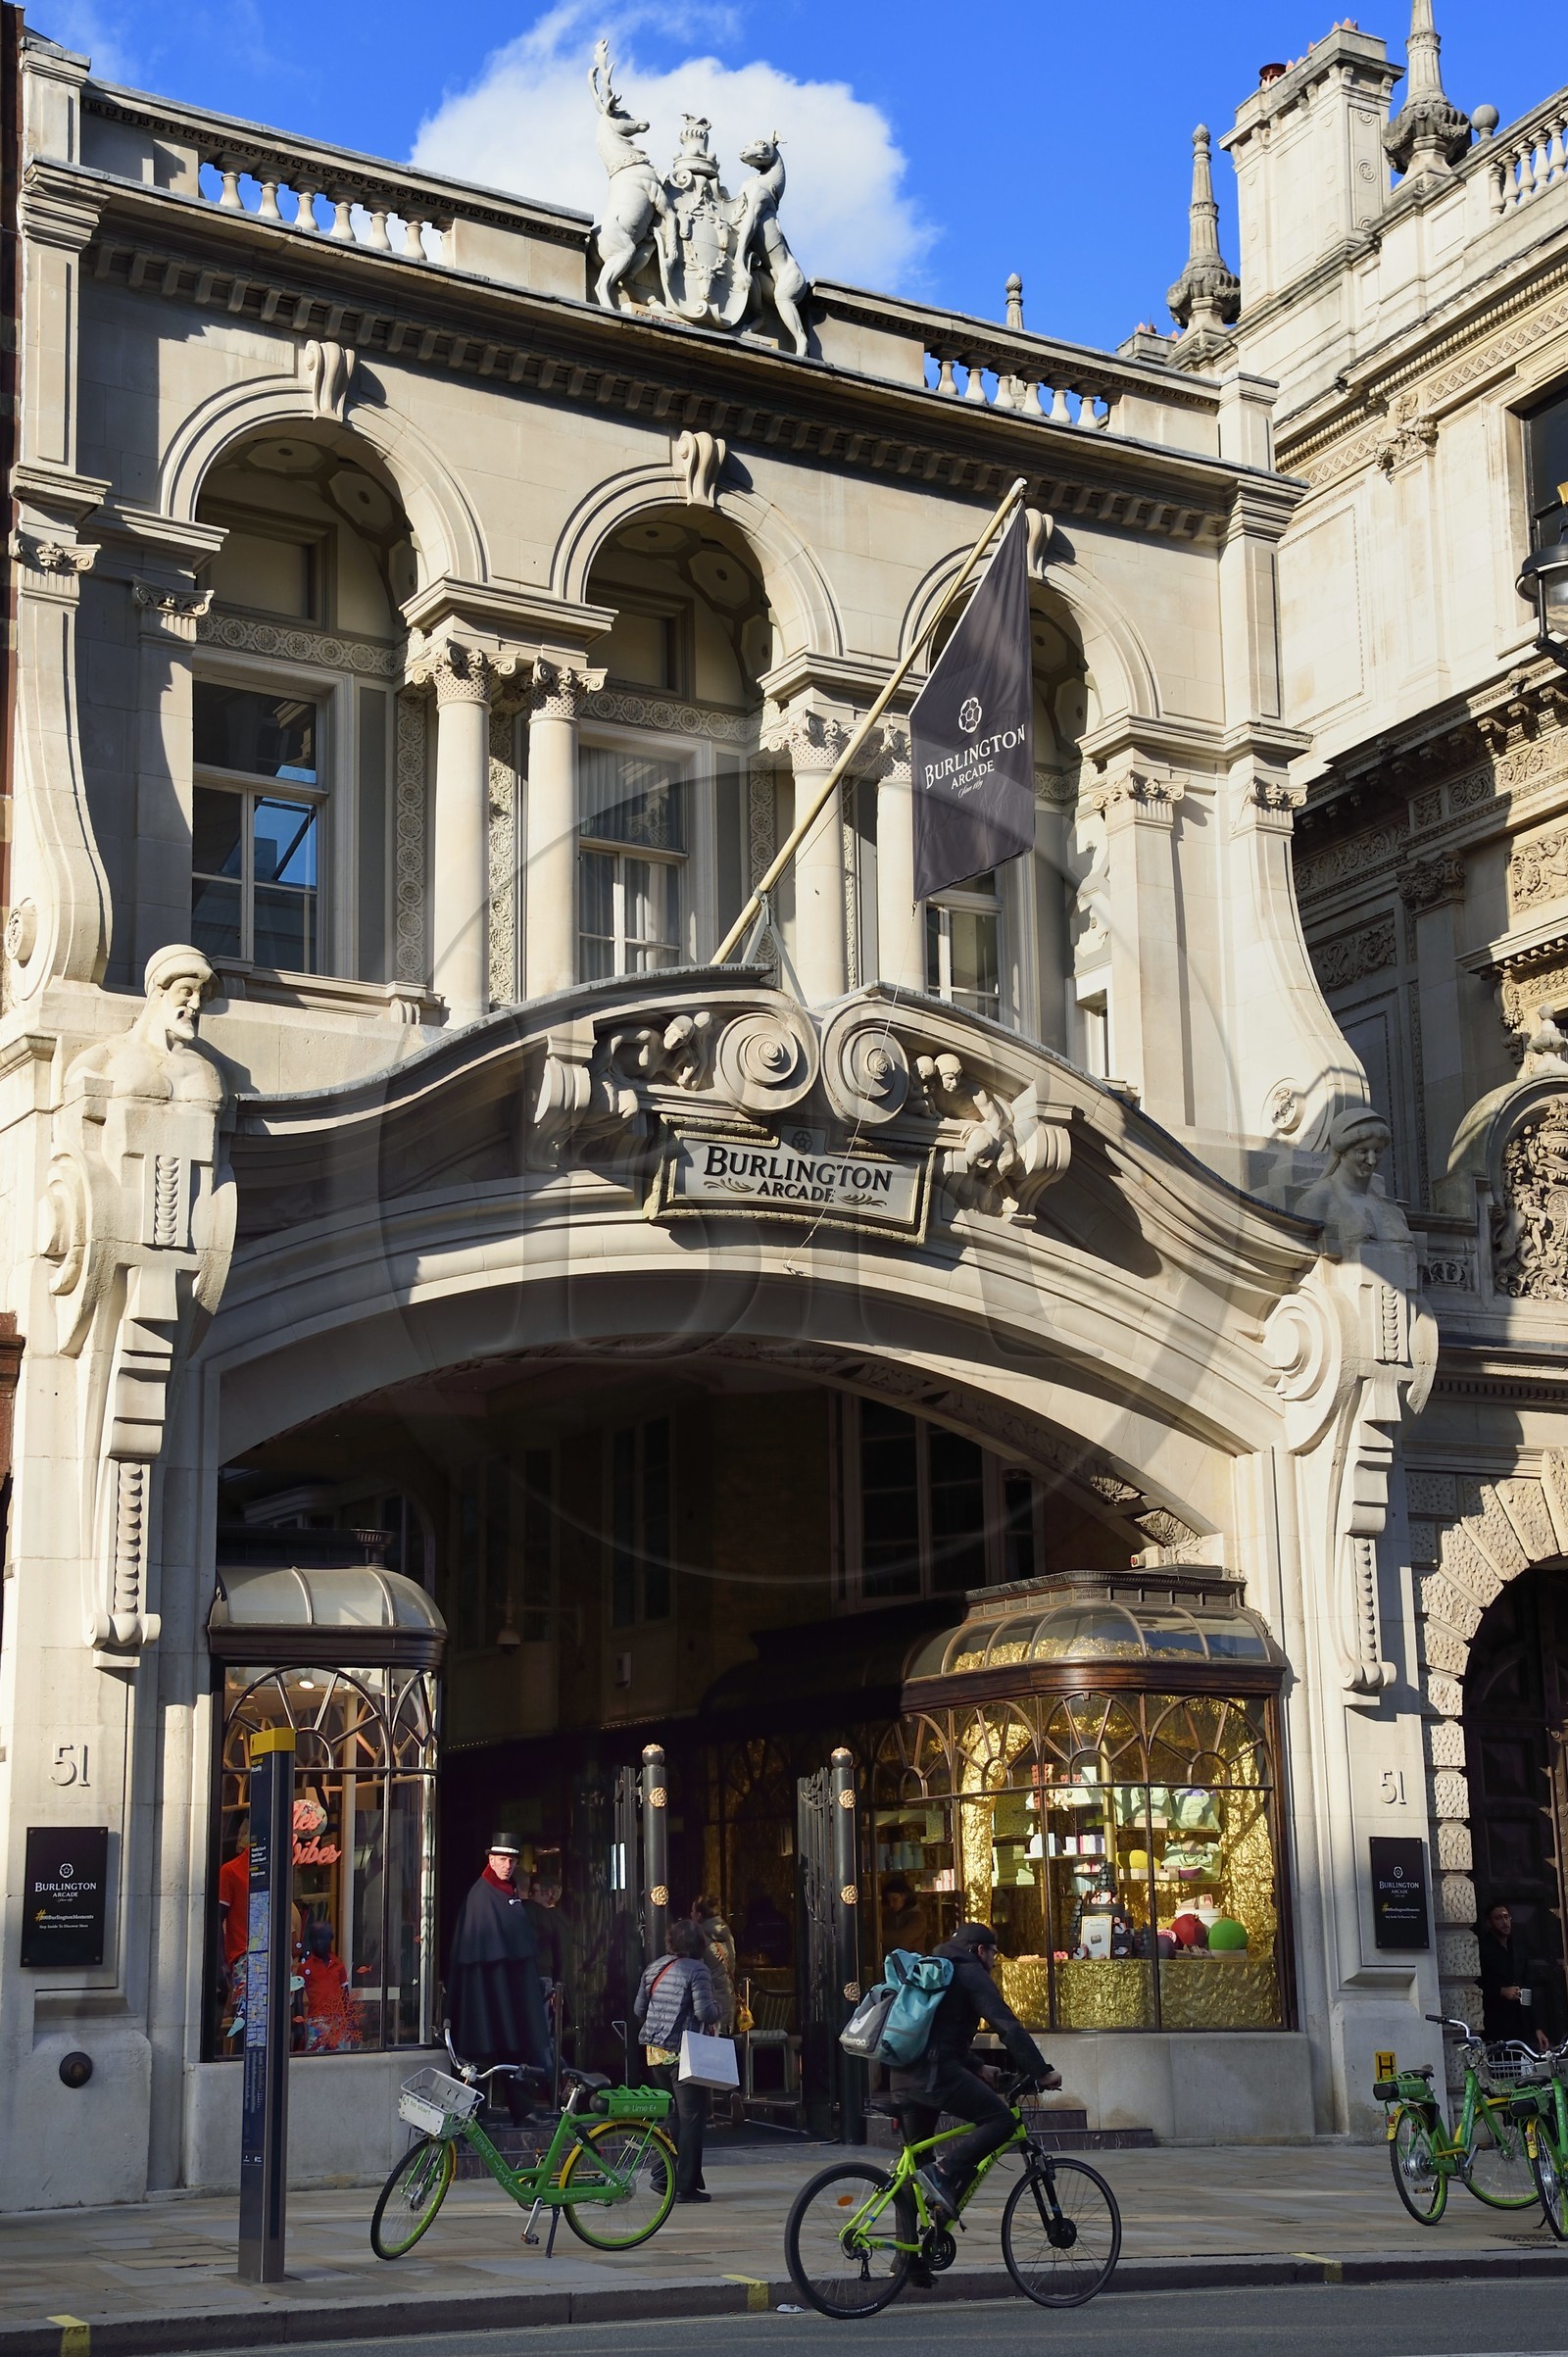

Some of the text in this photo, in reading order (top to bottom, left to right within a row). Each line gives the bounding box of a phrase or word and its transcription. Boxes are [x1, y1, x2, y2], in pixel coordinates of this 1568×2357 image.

[924, 723, 1026, 790] BURLINGTON
[951, 761, 995, 790] ARCADE
[703, 1145, 894, 1193] BURLINGTON
[756, 1180, 837, 1203] ARCADE
[49, 1743, 91, 1788] 51
[1379, 1768, 1407, 1805] 51
[34, 1882, 97, 1892] BURLINGTON
[1379, 1881, 1420, 1890] BURLINGTON
[1378, 2055, 1394, 2079] H
[417, 2104, 431, 2115] start
